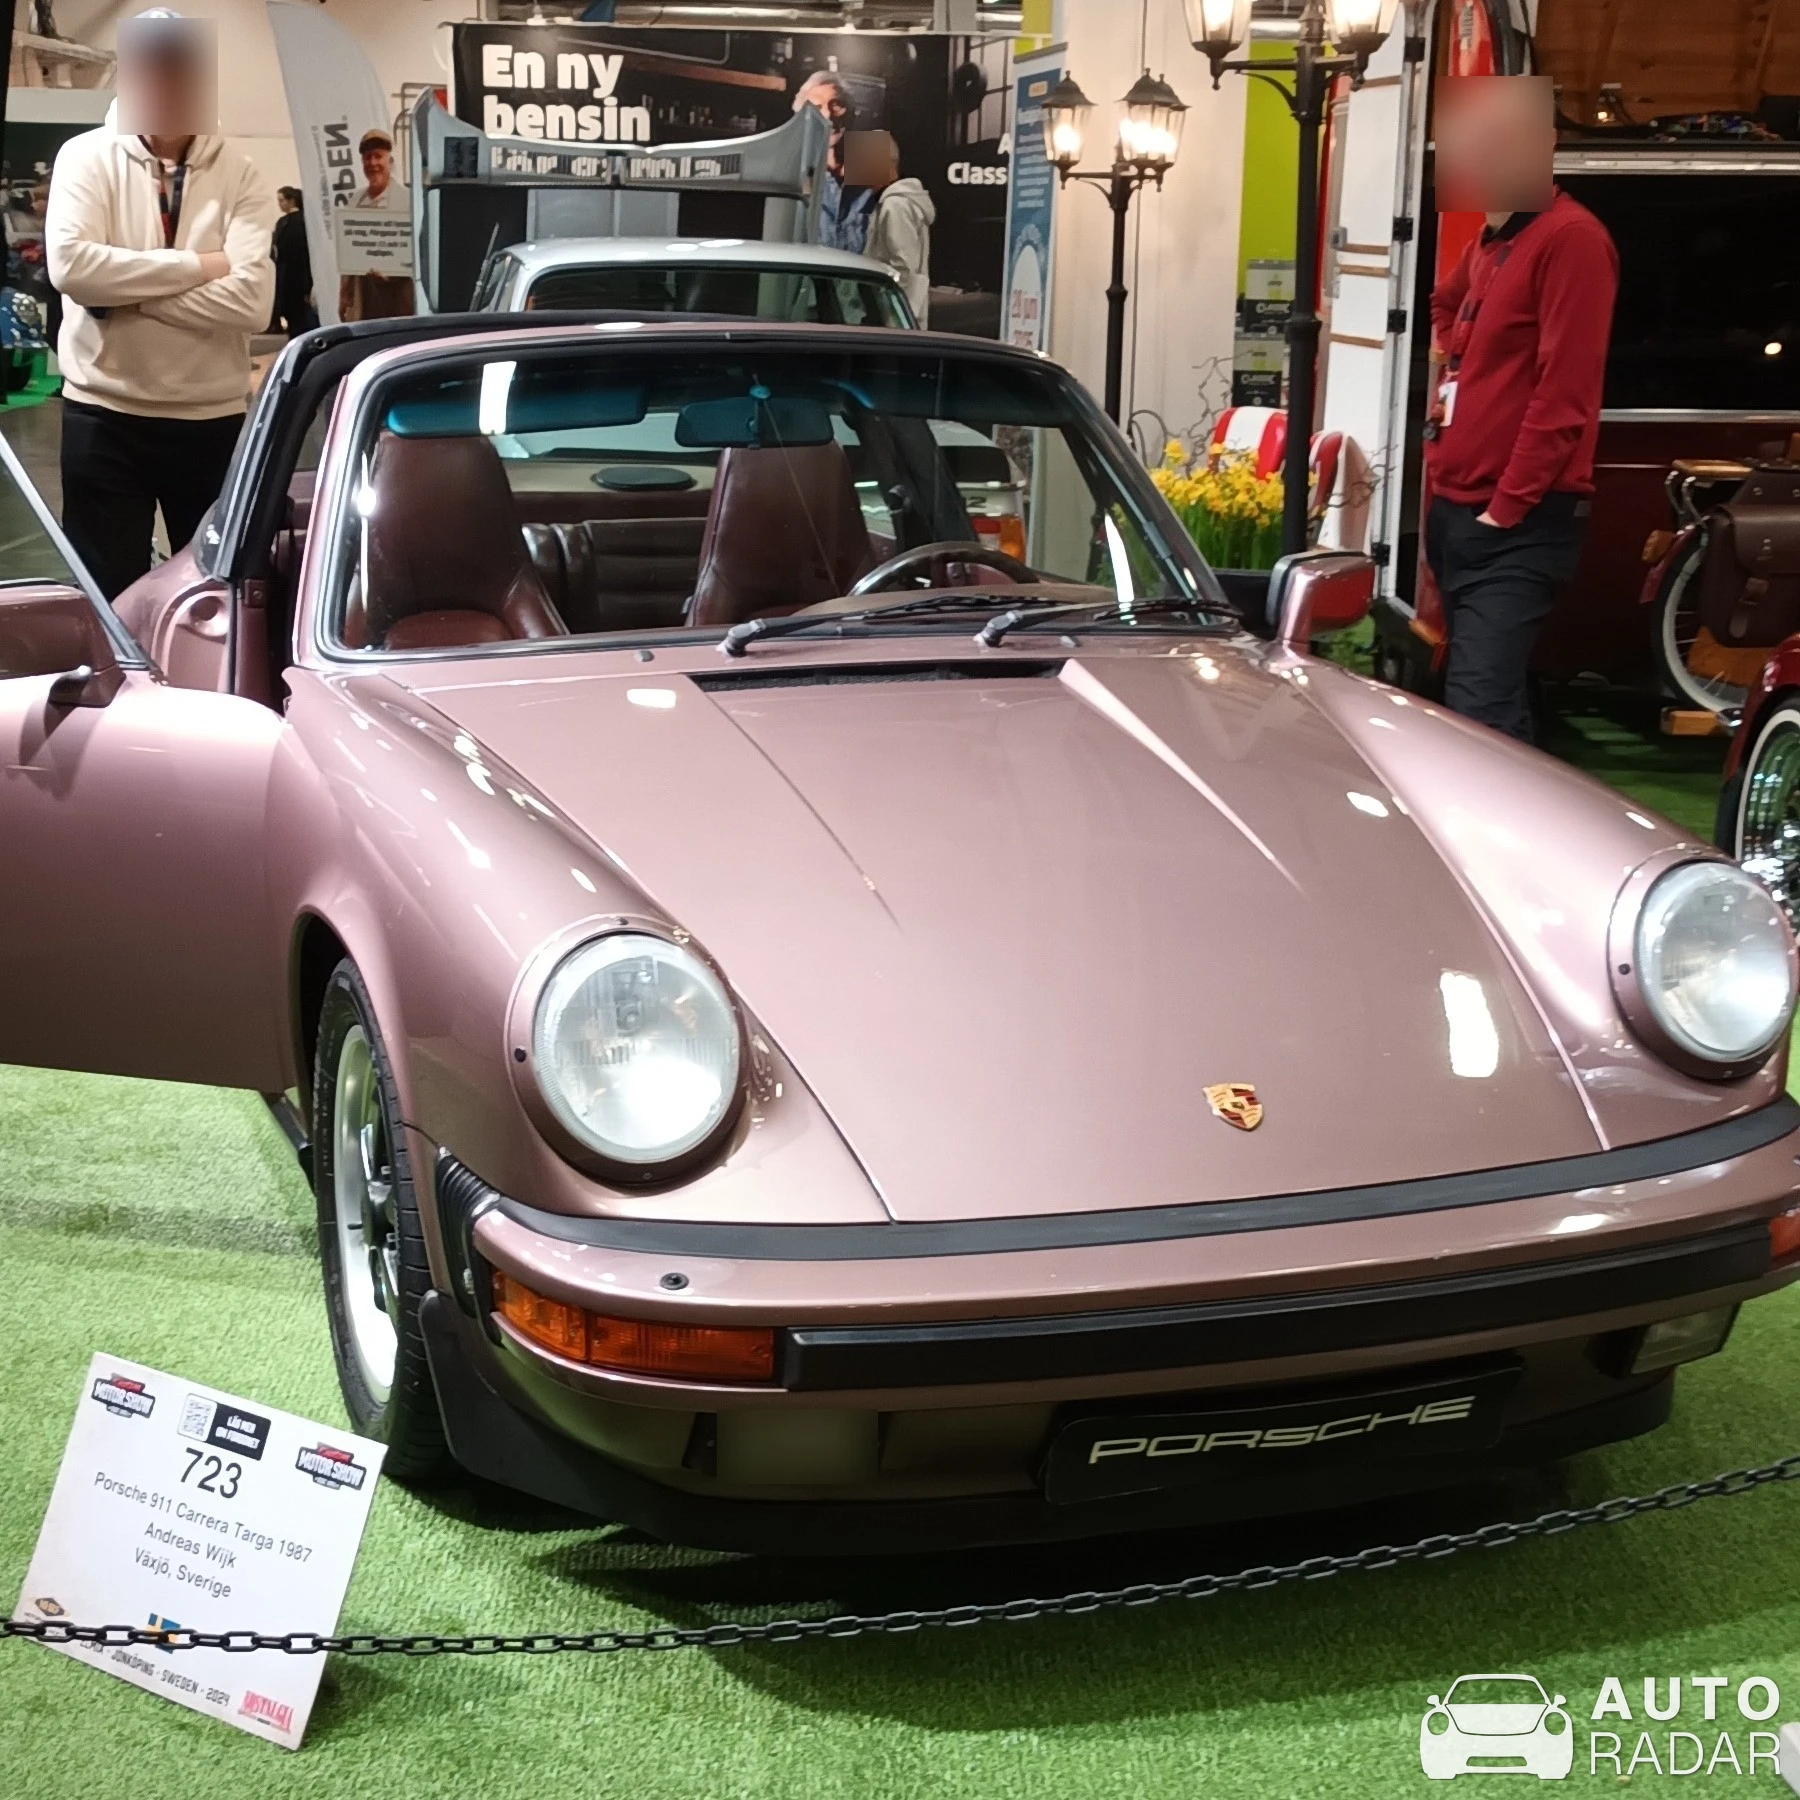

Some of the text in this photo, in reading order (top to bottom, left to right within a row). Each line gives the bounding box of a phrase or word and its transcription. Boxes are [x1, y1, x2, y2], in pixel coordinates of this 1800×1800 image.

[482, 44, 624, 98] En ny
[483, 95, 651, 142] bensin
[947, 161, 1007, 185] Class
[1088, 1396, 1476, 1464] PORSCHE
[180, 1446, 242, 1499] 723
[94, 1471, 313, 1563] Porsche 911 Carrera Targa 1987
[144, 1522, 237, 1570] Andreas Wijk
[176, 1564, 231, 1599] Sverige
[160, 1669, 199, 1694] SWEDEN
